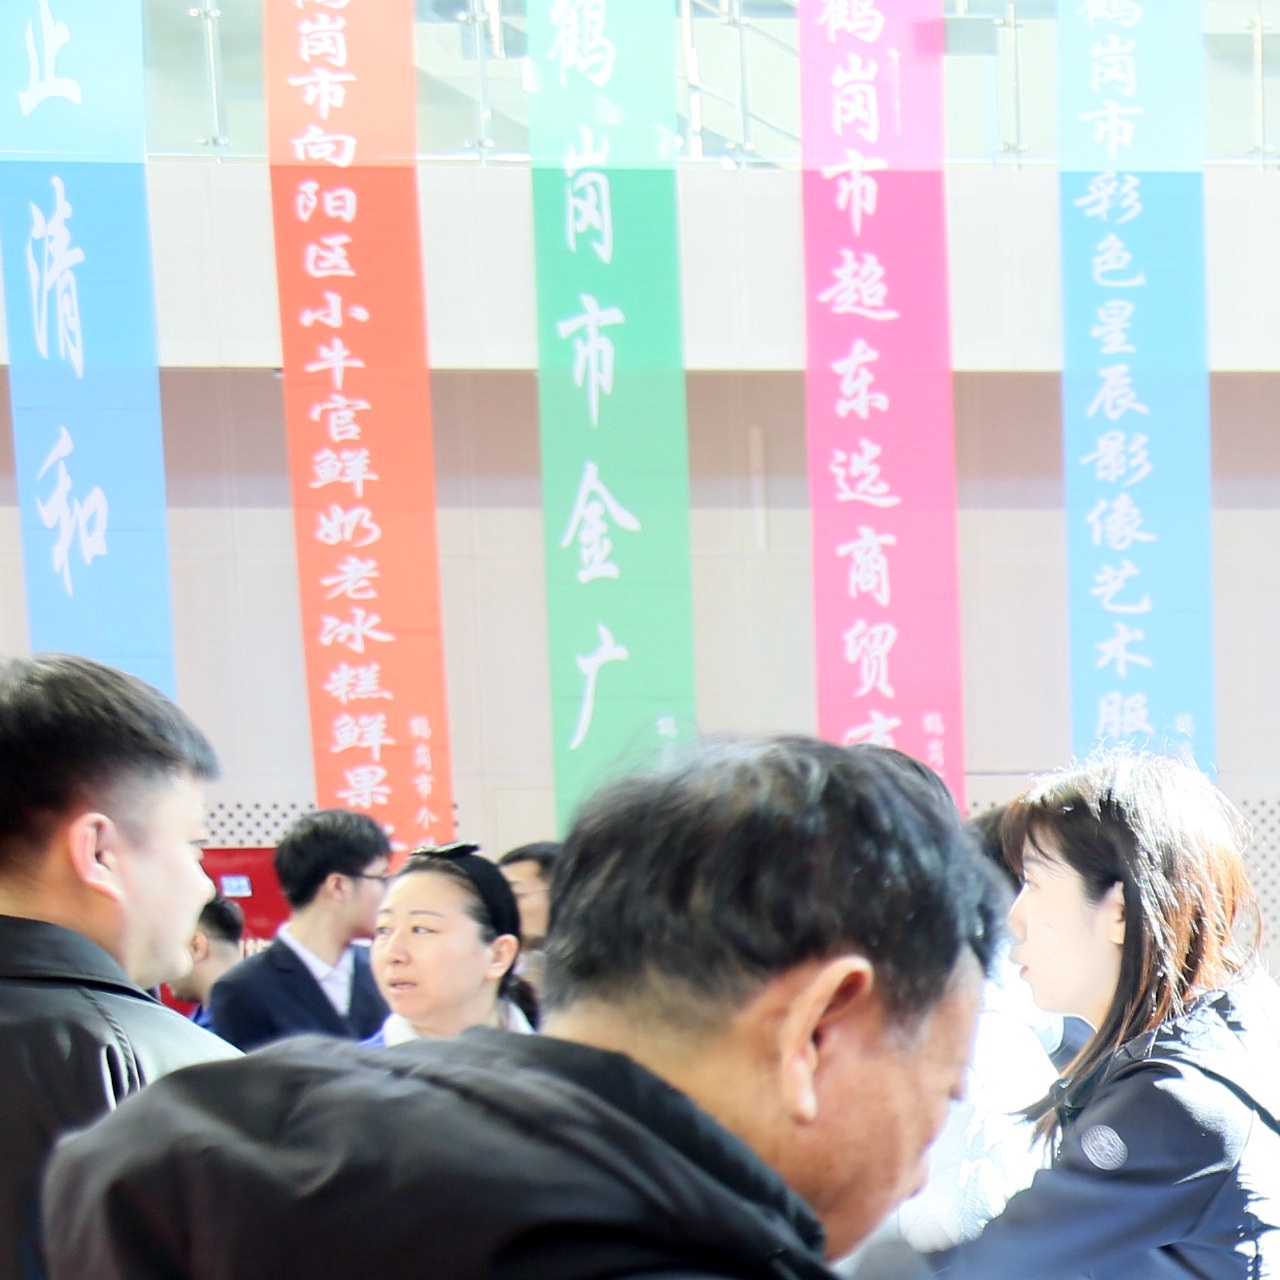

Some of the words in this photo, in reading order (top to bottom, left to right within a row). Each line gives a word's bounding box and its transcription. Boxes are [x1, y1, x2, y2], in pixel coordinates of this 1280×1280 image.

[288, 0, 408, 854] 岗市向阳区小牛官鲜奶老冰糕鲜果
